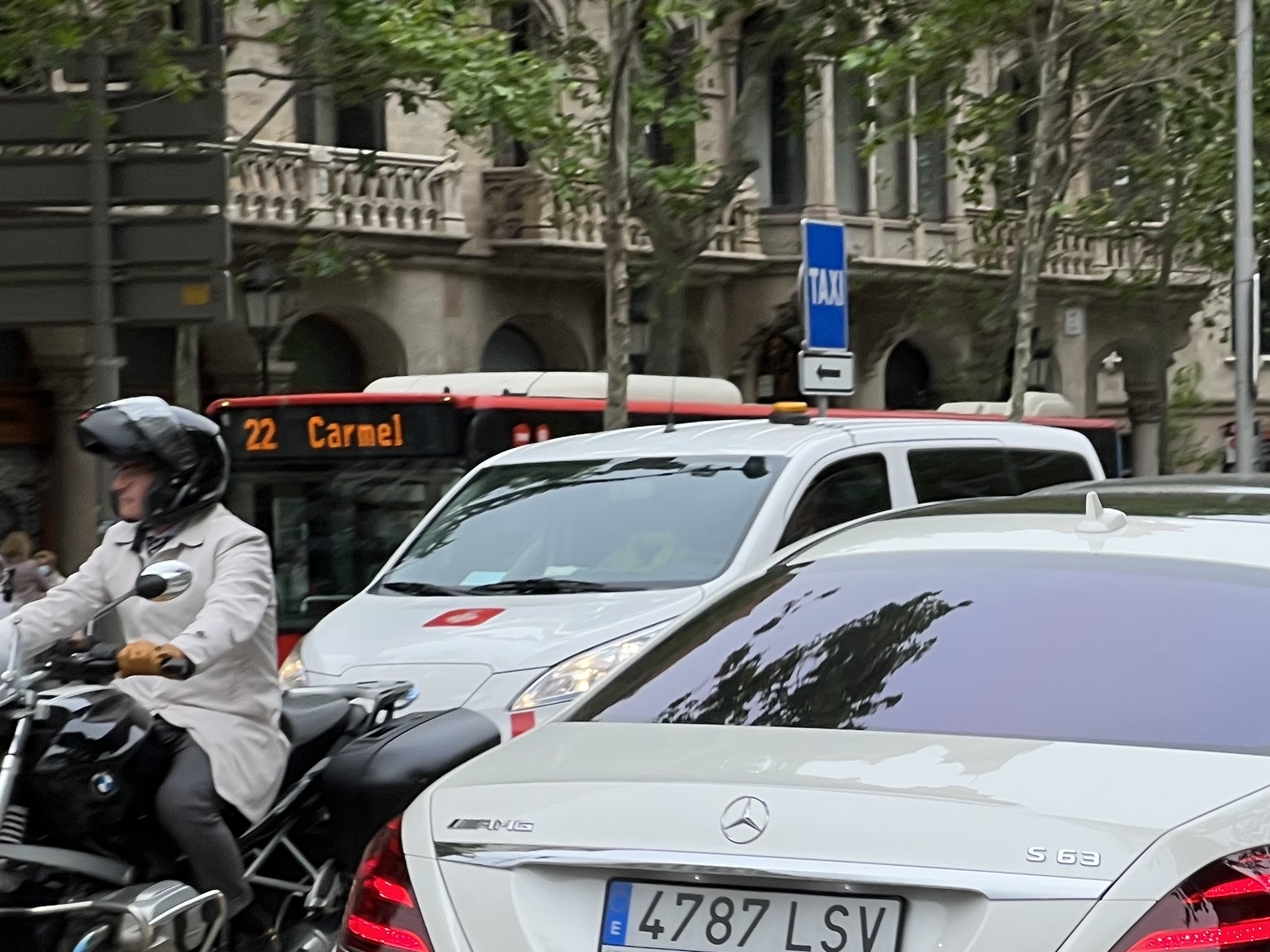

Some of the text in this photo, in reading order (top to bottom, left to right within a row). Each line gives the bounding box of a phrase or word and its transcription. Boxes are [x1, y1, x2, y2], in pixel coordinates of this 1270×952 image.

[808, 267, 844, 306] TAXI
[243, 413, 404, 450] 22 Carmel
[1025, 846, 1102, 867] S 63
[610, 920, 622, 936] E
[638, 890, 771, 948] 4787
